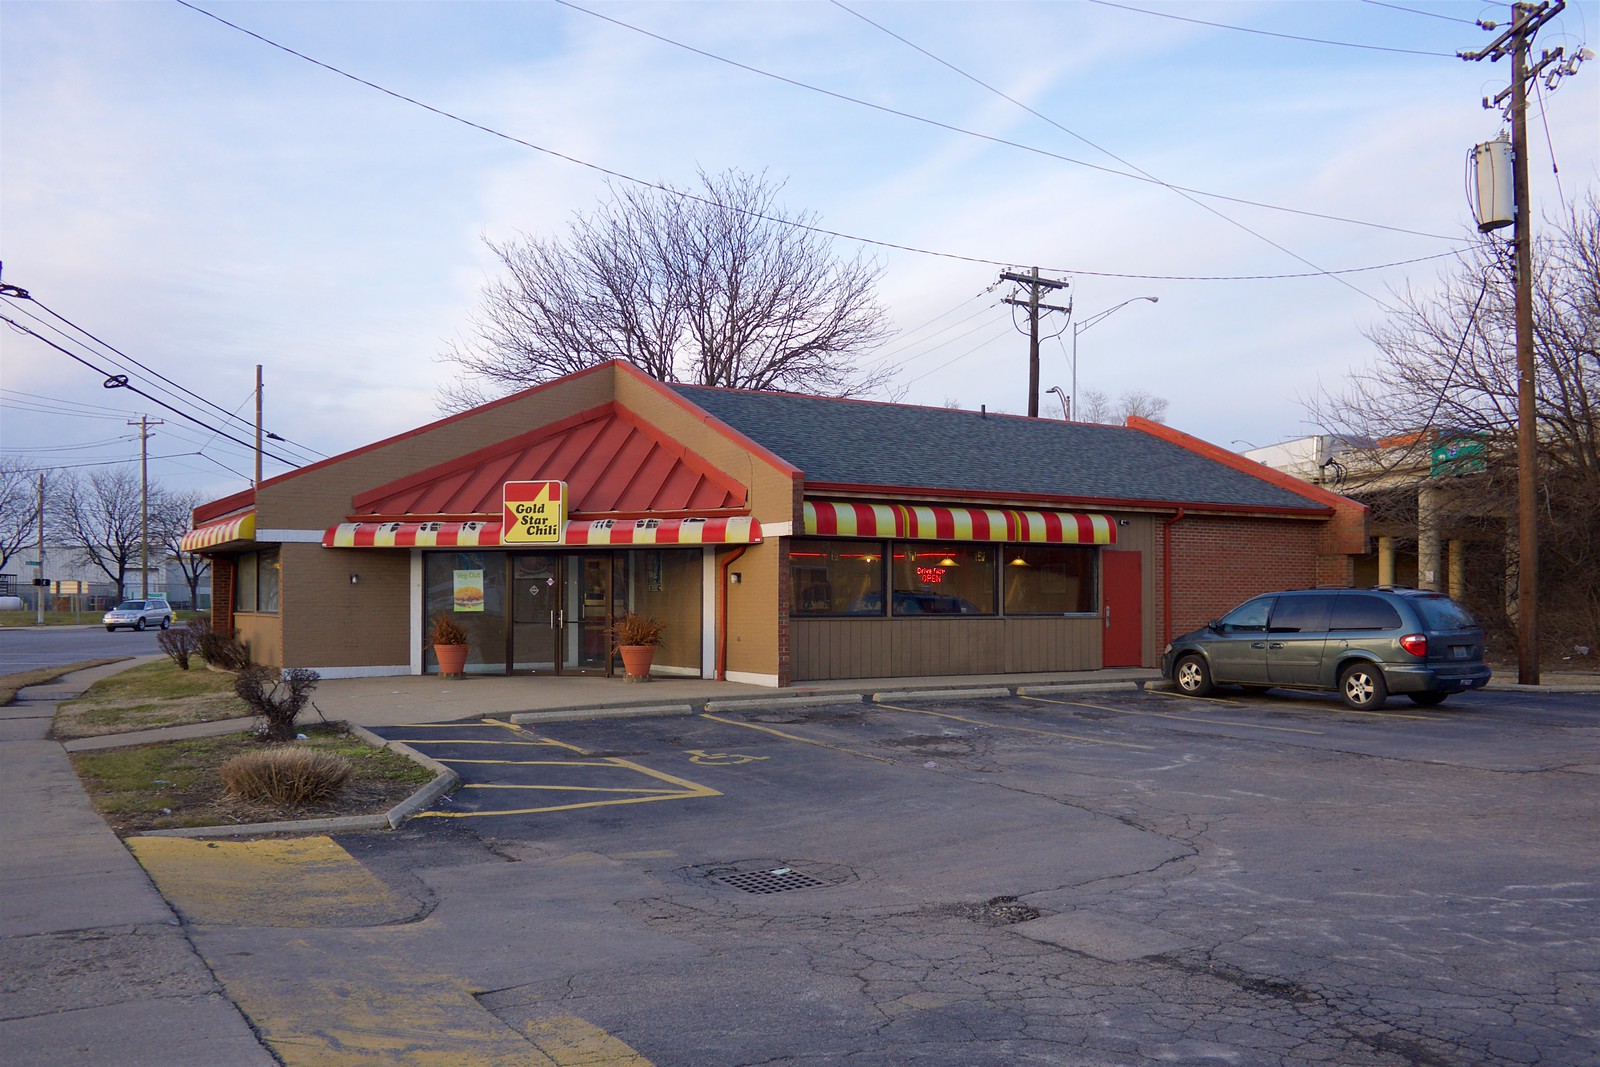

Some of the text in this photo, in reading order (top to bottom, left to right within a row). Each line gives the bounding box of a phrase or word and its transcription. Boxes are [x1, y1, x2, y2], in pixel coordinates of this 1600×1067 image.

[515, 503, 545, 514] Gold
[520, 515, 549, 525] Star
[526, 524, 557, 536] Chili
[921, 574, 942, 583] OPEN
